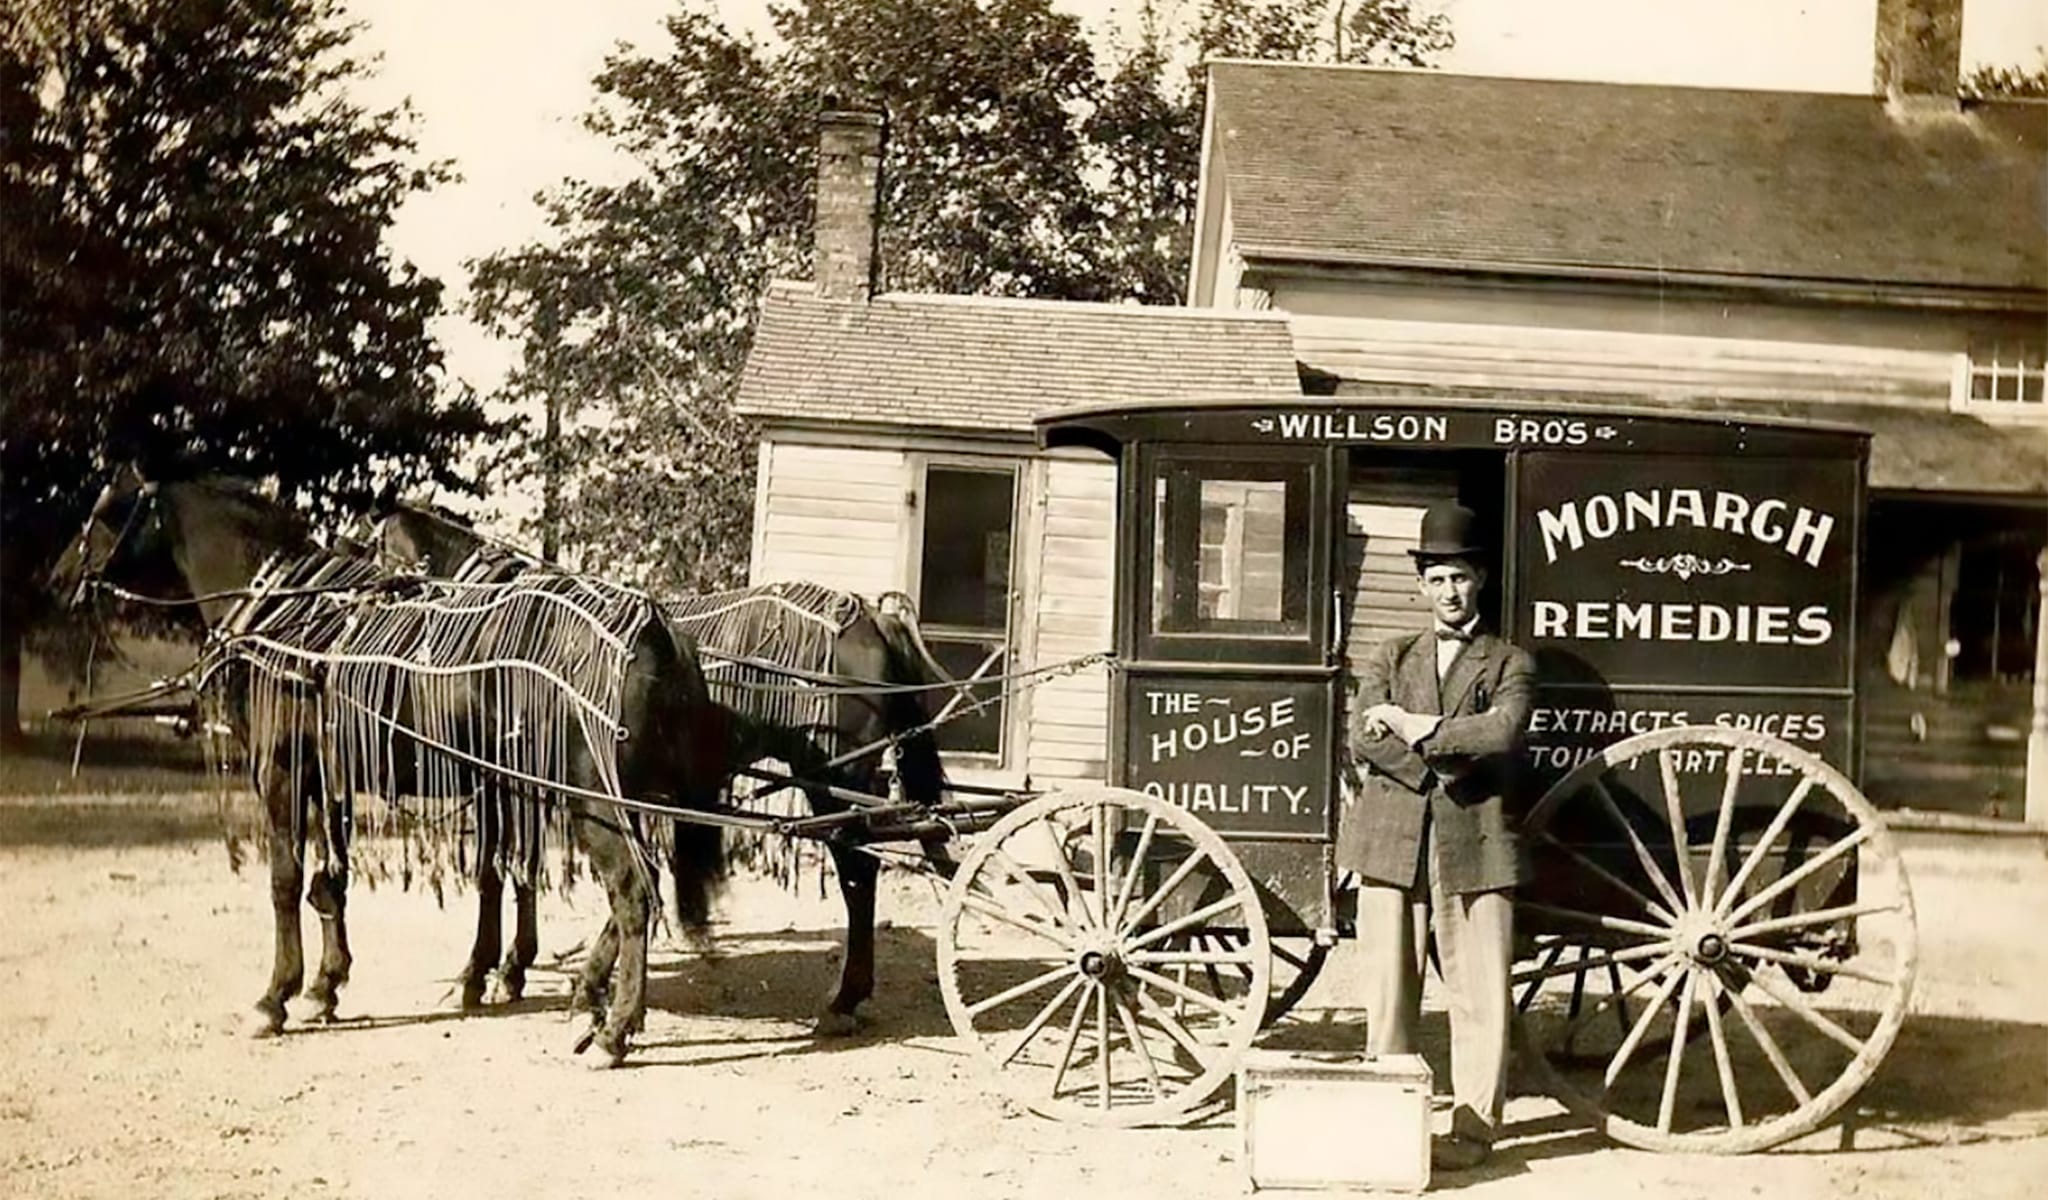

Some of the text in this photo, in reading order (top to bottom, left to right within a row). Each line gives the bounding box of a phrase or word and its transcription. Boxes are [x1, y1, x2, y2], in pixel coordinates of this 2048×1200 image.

[1278, 414, 1448, 441] WILLSON
[1536, 488, 1835, 568] MONARCH
[1532, 600, 1832, 645] REMEDIES
[1152, 697, 1295, 762] HOUSE
[1527, 708, 1826, 741] EXTRACTS SPICES
